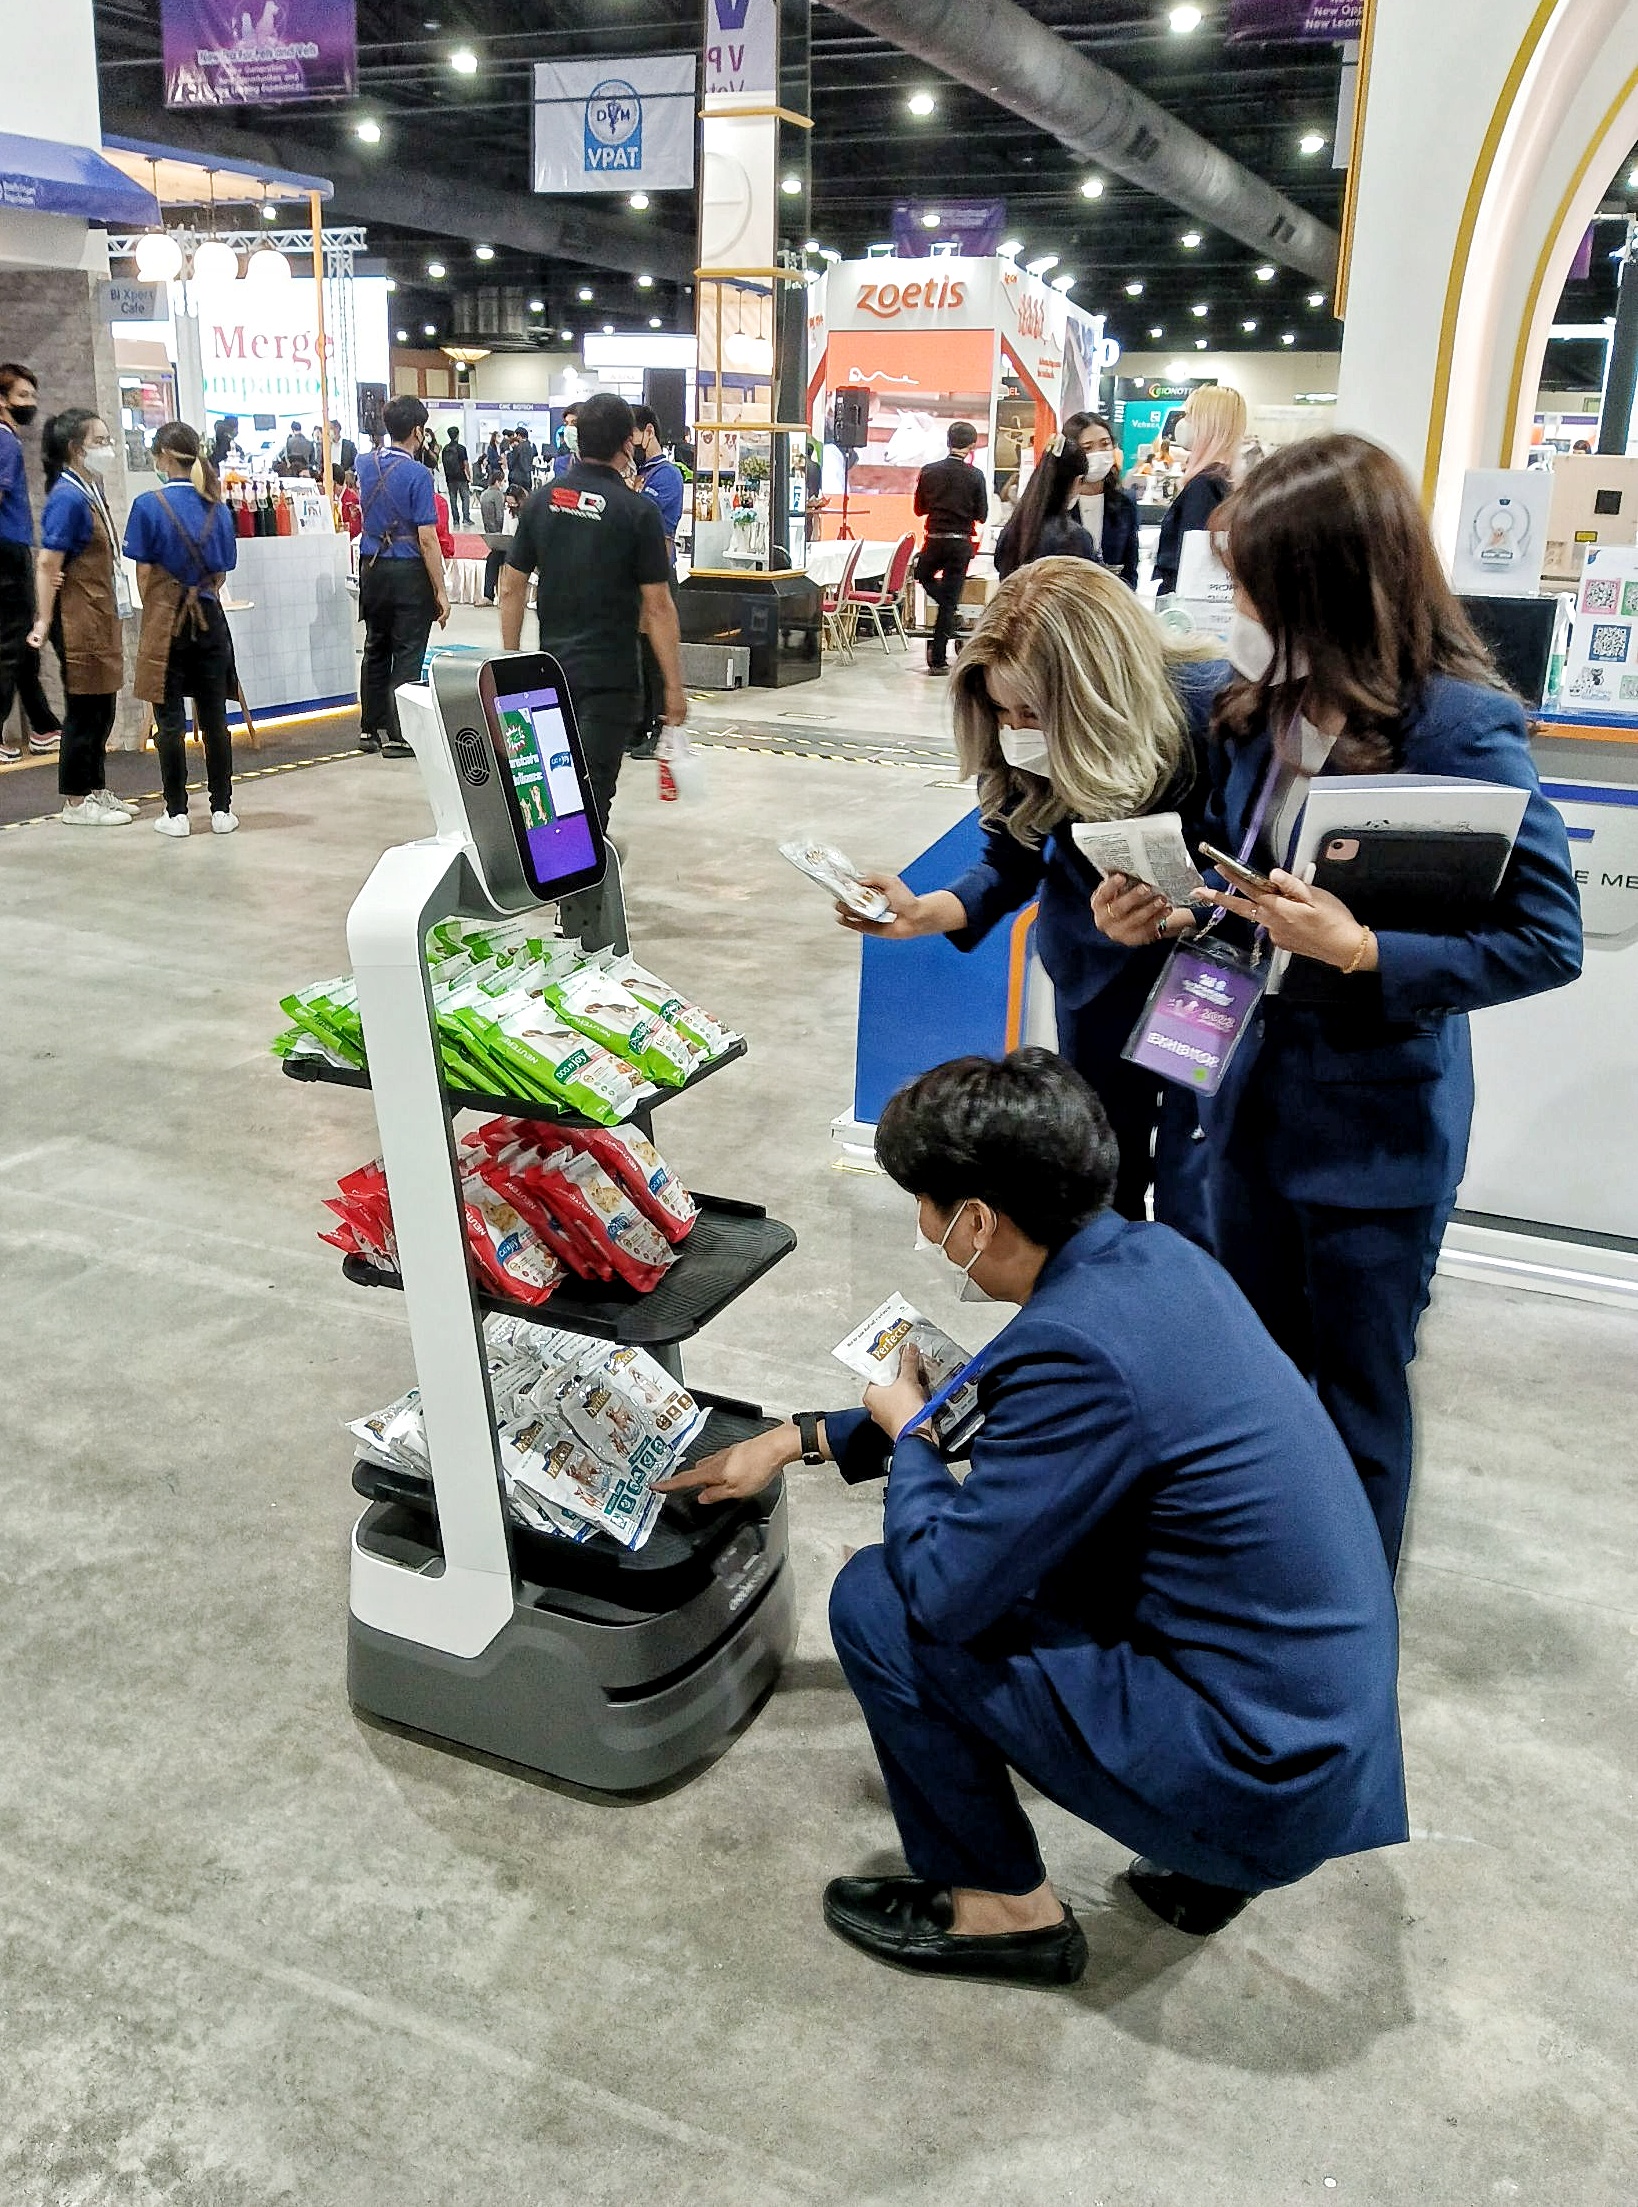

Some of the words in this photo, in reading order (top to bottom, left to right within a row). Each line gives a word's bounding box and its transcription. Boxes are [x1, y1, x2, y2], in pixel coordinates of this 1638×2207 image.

[587, 147, 639, 169] VPAT
[120, 302, 146, 315] Cafe
[857, 275, 966, 319] zoetis
[1146, 1032, 1220, 1067] EXHIBITOR
[871, 1322, 911, 1361] Perfecta
